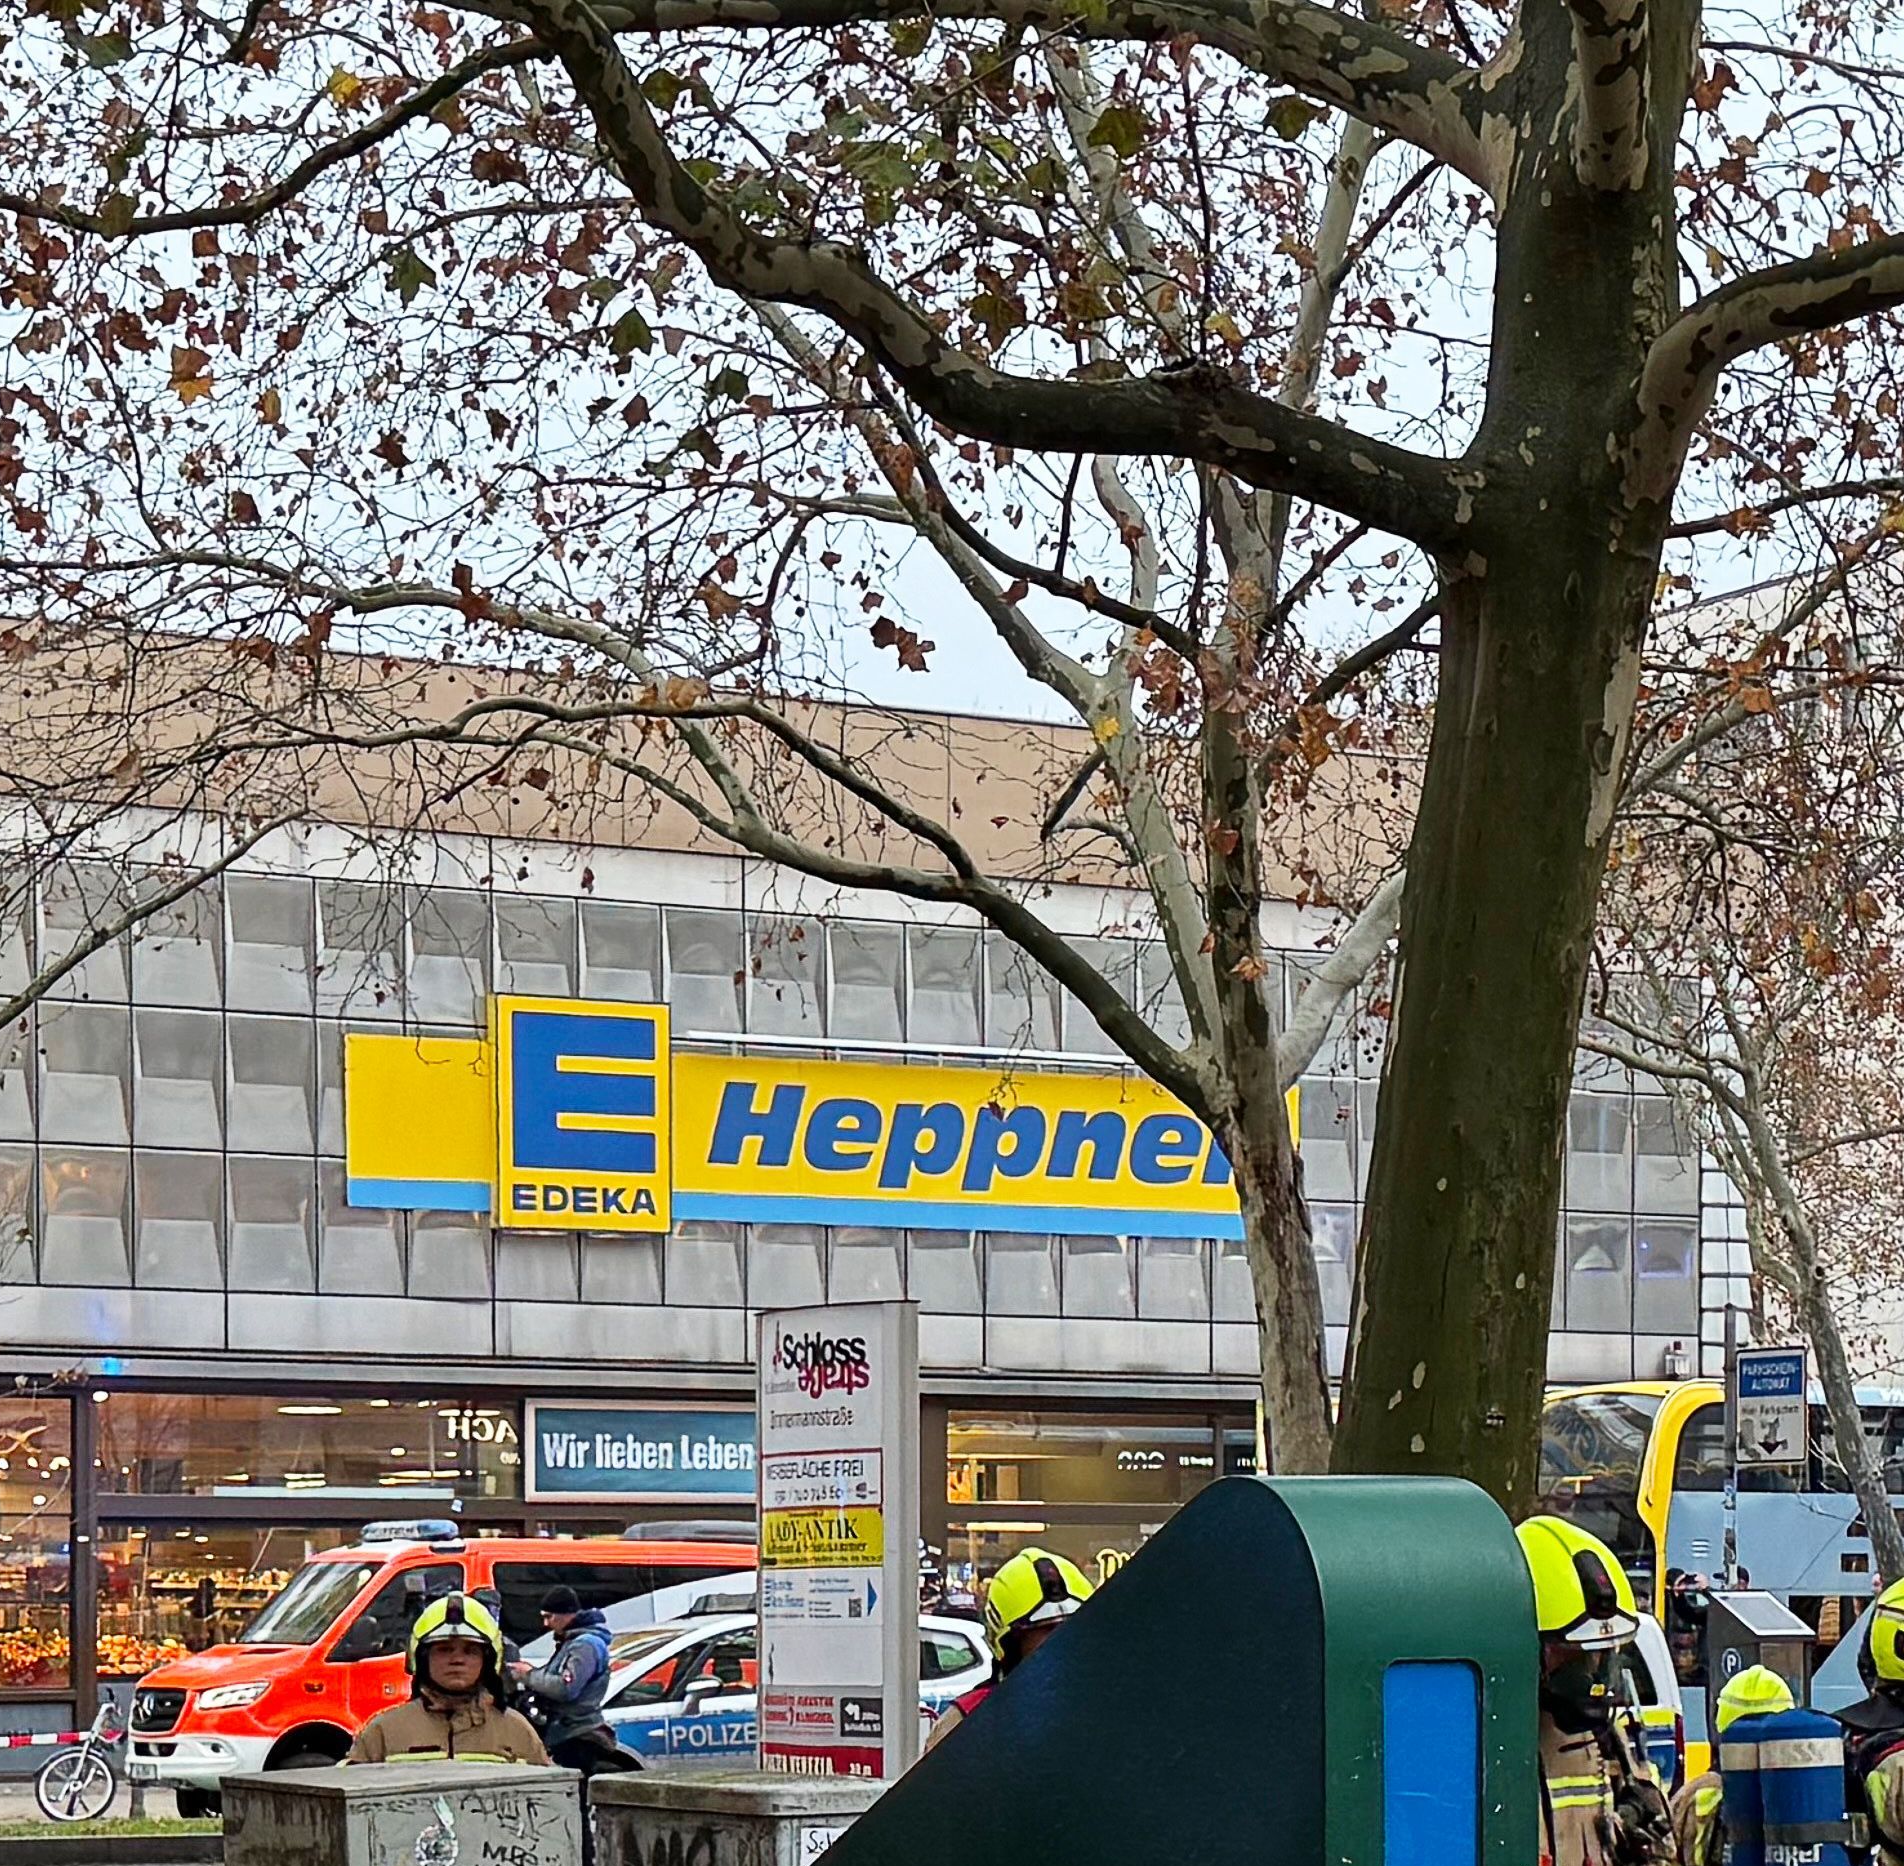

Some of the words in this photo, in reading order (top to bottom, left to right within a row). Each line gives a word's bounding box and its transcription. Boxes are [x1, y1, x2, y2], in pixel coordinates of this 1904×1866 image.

[511, 1184, 657, 1216] EDEKA
[782, 1331, 866, 1370] Schloss
[542, 1432, 590, 1470] Wir
[595, 1433, 673, 1470] lieben
[671, 1721, 757, 1748] POLIZE
